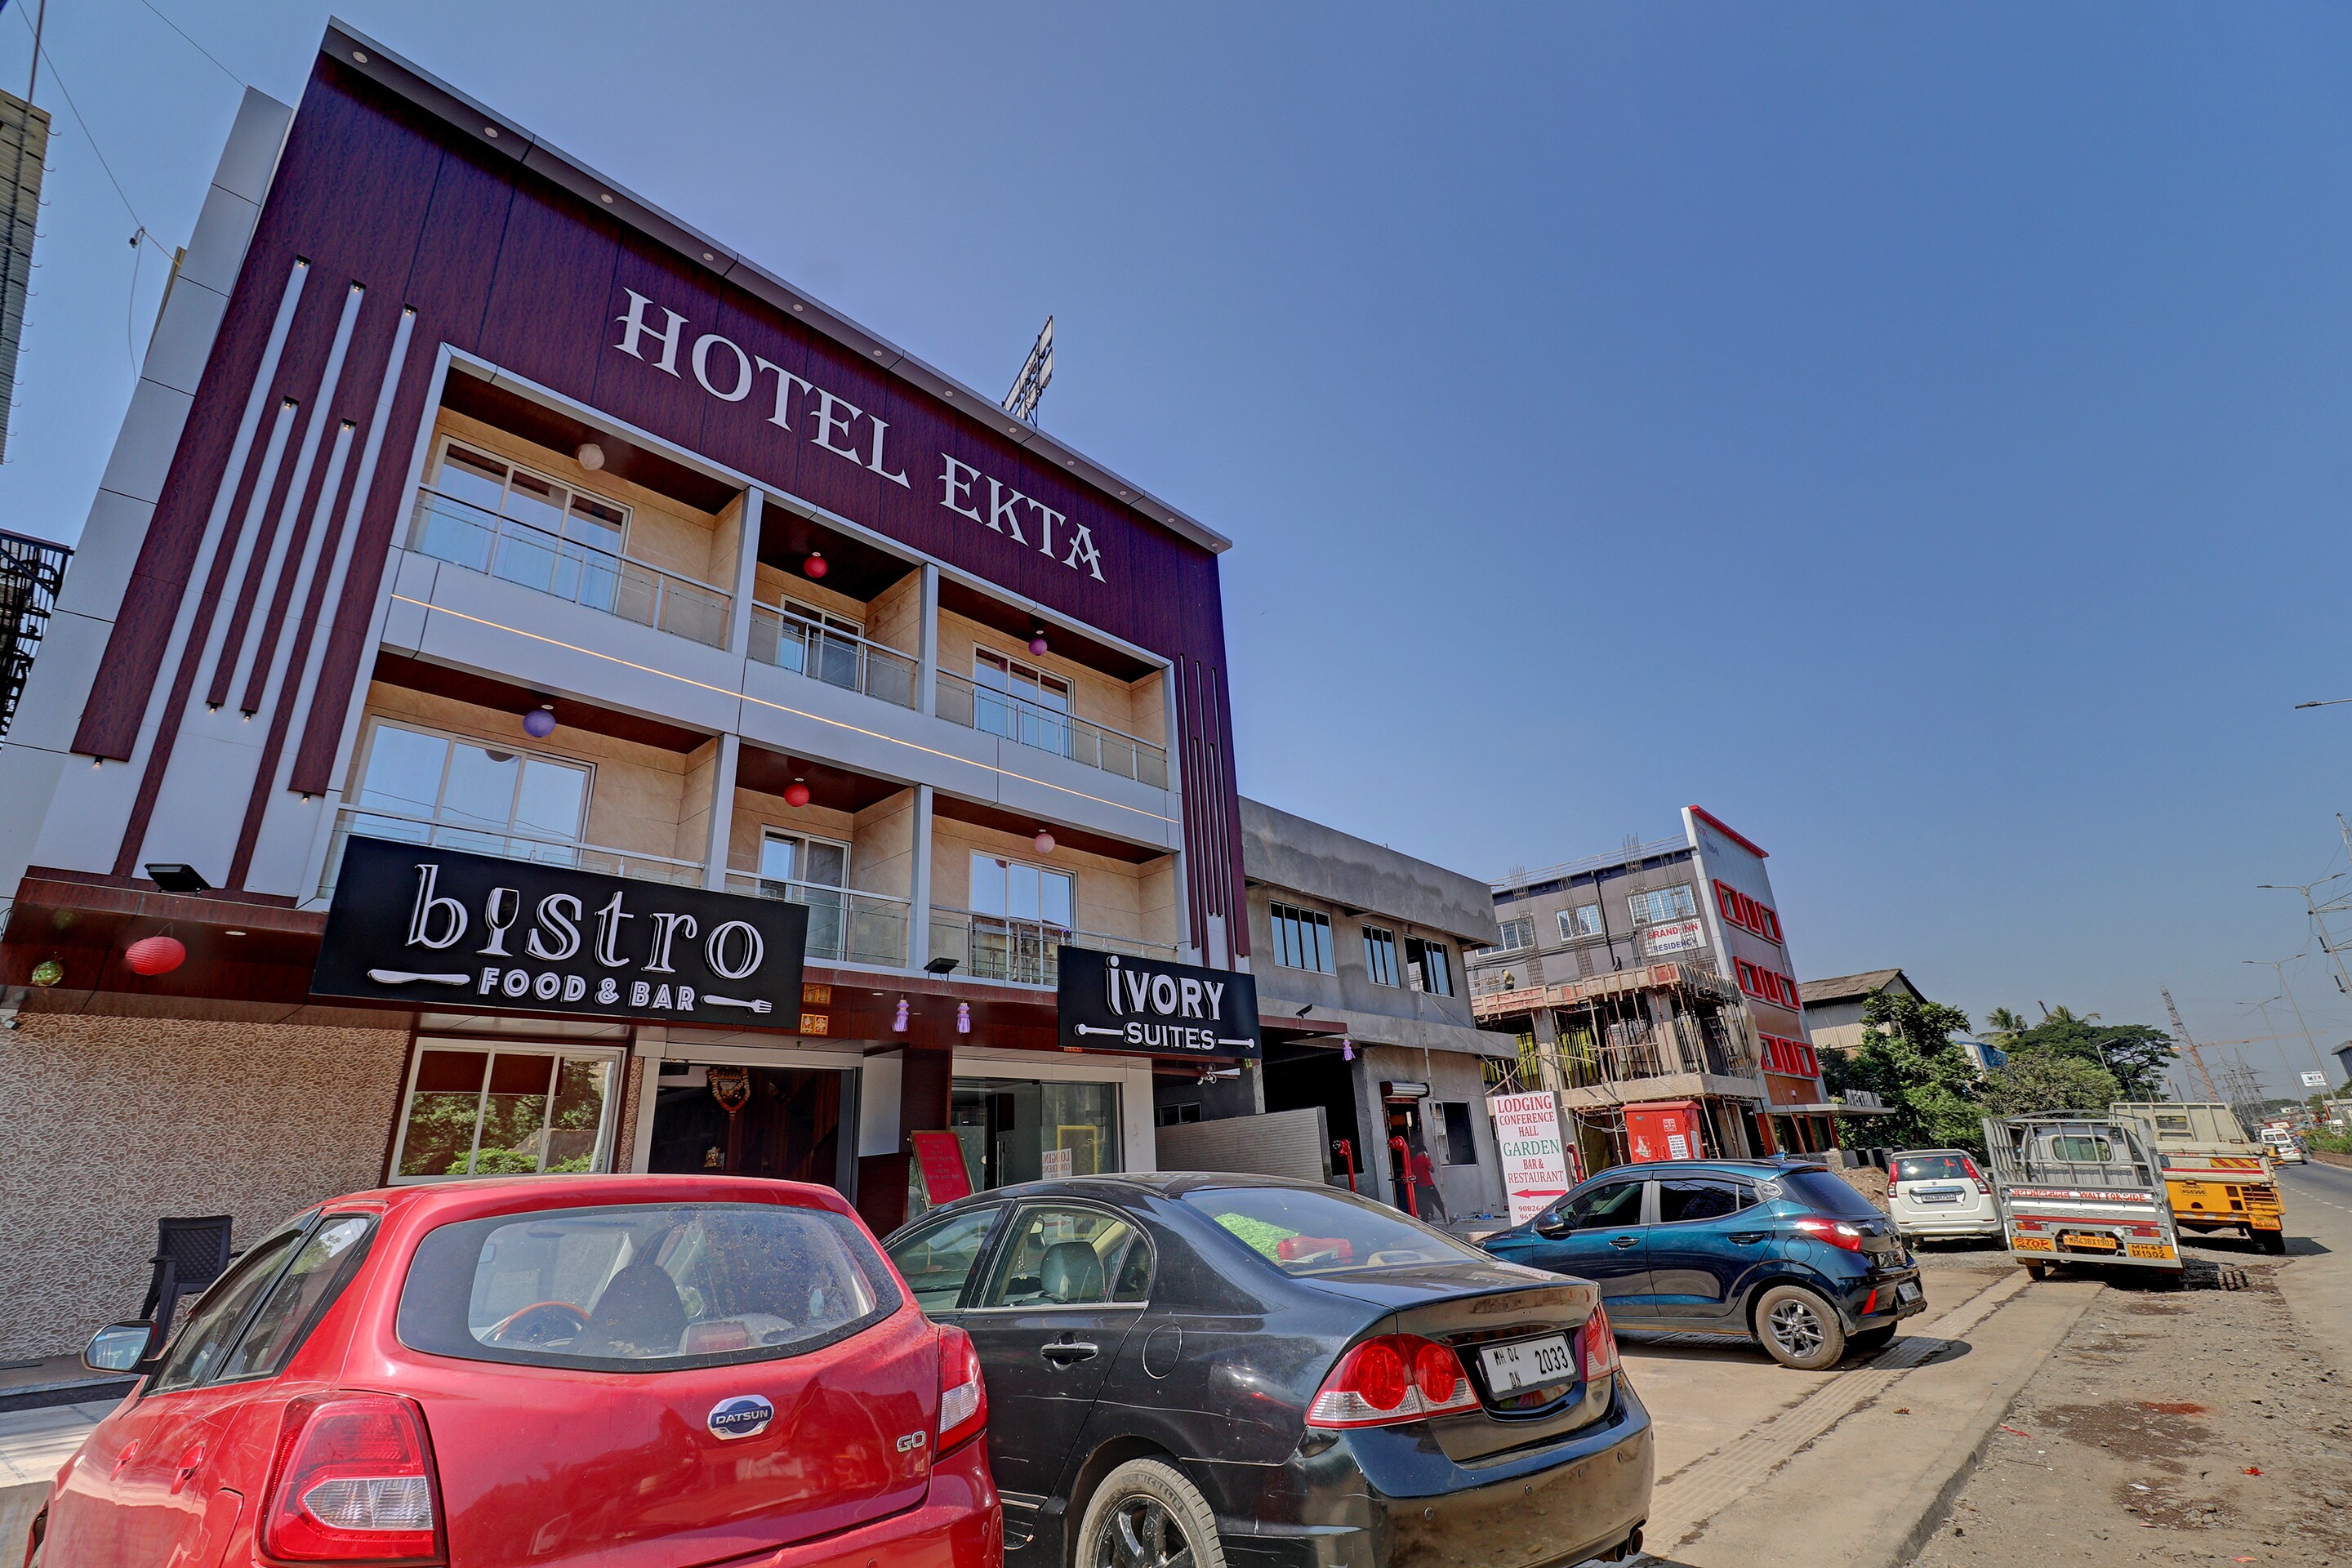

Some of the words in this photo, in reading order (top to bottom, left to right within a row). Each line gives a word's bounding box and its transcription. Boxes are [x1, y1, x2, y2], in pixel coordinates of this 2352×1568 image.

[612, 287, 911, 490] HOTEL
[937, 452, 1107, 584] EKTA
[404, 863, 764, 980] bistro
[1646, 926, 1679, 940] GRAND
[1682, 922, 1699, 932] INN
[1653, 937, 1699, 953] RESIDENCY
[477, 967, 586, 1003] FOOD
[595, 976, 620, 1005] &
[628, 980, 695, 1012] BAR
[1124, 1022, 1215, 1050] SUITES
[1497, 1095, 1552, 1114] LODGING
[1499, 1111, 1555, 1126] CONFERENCE
[1518, 1125, 1539, 1137] HALL
[1503, 1138, 1560, 1156] GARDEN
[1522, 1158, 1537, 1170] BAR
[1538, 1158, 1544, 1169] &
[1508, 1170, 1564, 1184] RESTAURANT
[2079, 1192, 2101, 1200] WAIT
[2015, 1238, 2048, 1247] STOP
[1493, 1349, 1507, 1366] MH
[1507, 1347, 1520, 1362] 04
[1535, 1346, 1568, 1374] 2033
[715, 1409, 768, 1425] DATSUN
[897, 1430, 926, 1453] GO
[1138, 1474, 1184, 1512] MICHELIN
